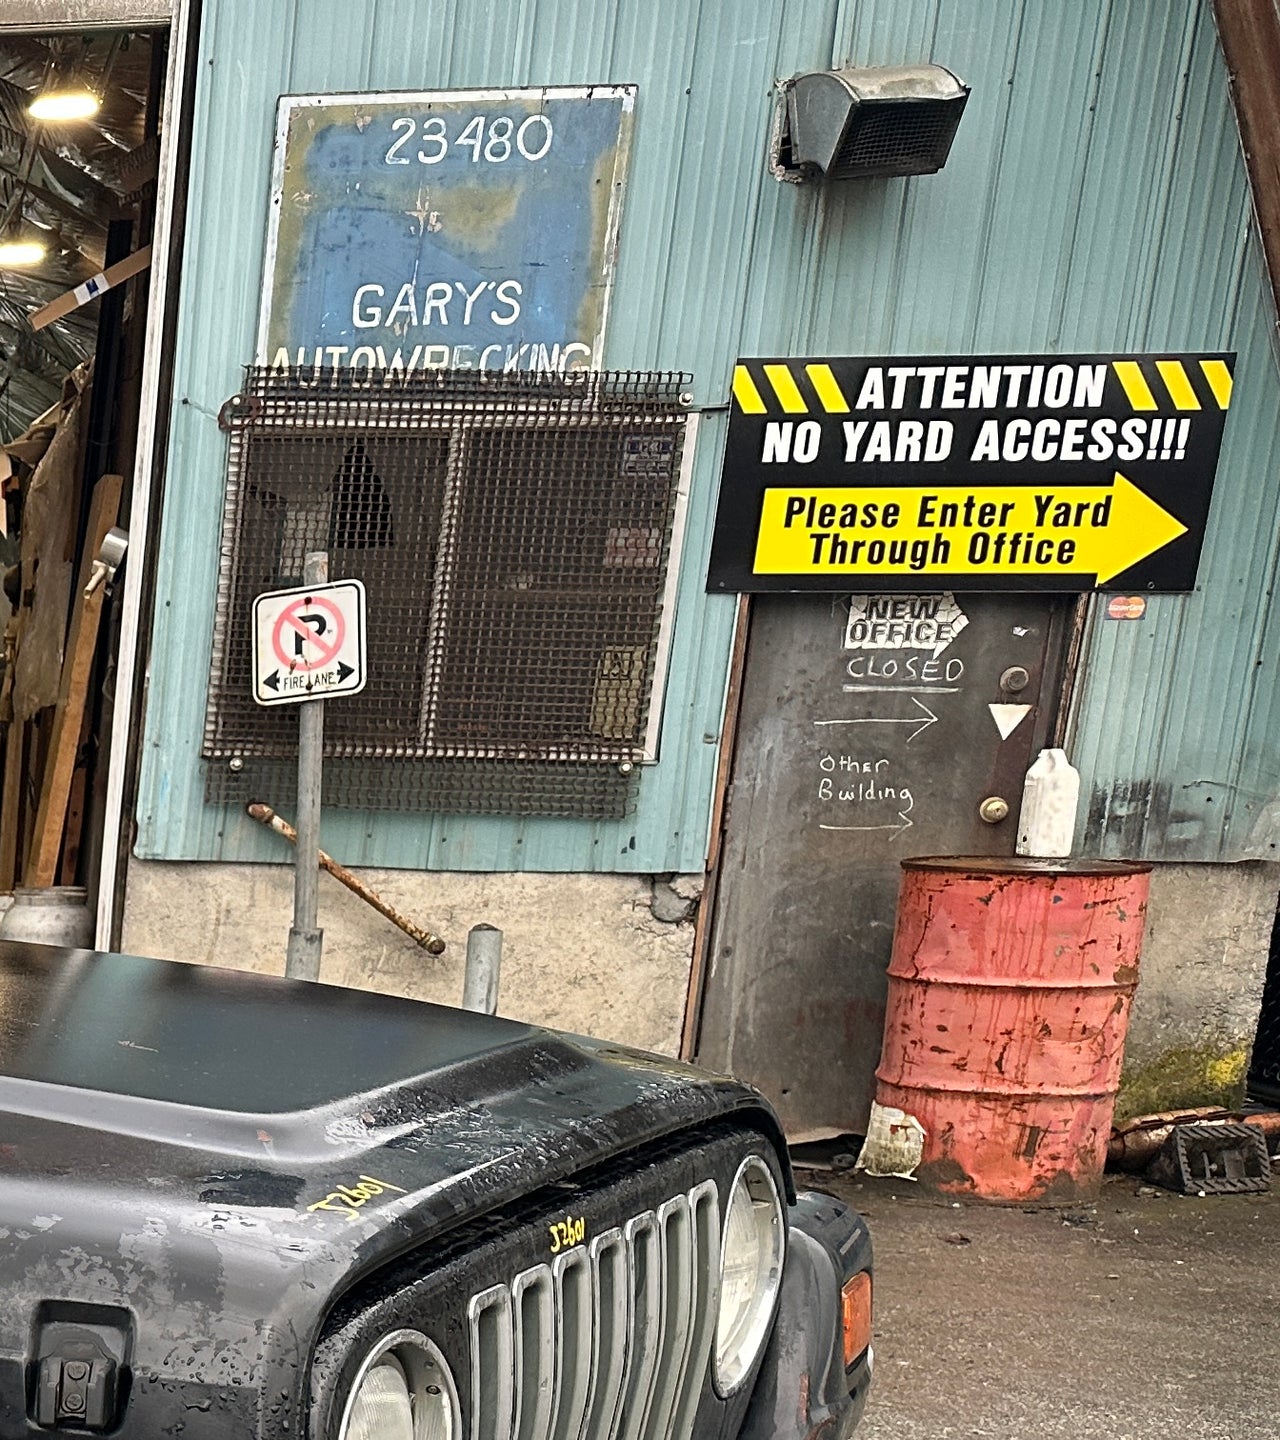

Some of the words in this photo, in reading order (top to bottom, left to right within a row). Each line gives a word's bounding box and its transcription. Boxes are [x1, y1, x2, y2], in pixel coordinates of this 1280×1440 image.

[385, 115, 553, 164] 23480
[352, 280, 522, 328] GARY'S
[855, 364, 1107, 410] ATTENTION
[761, 422, 821, 463] NO
[843, 420, 954, 462] YARD
[970, 419, 1191, 461] ACCESS!!!
[783, 496, 900, 529] Please
[917, 496, 1016, 528] Enter
[1034, 494, 1113, 527] Yard
[809, 532, 951, 570] Through
[967, 531, 1077, 564] Office
[865, 599, 939, 620] NEW
[849, 618, 953, 643] OFFICE
[283, 675, 305, 690] FIRE
[846, 656, 965, 682] CLOSED
[818, 778, 914, 812] Building
[307, 1175, 408, 1221] J2601
[550, 1216, 585, 1252] J2601
